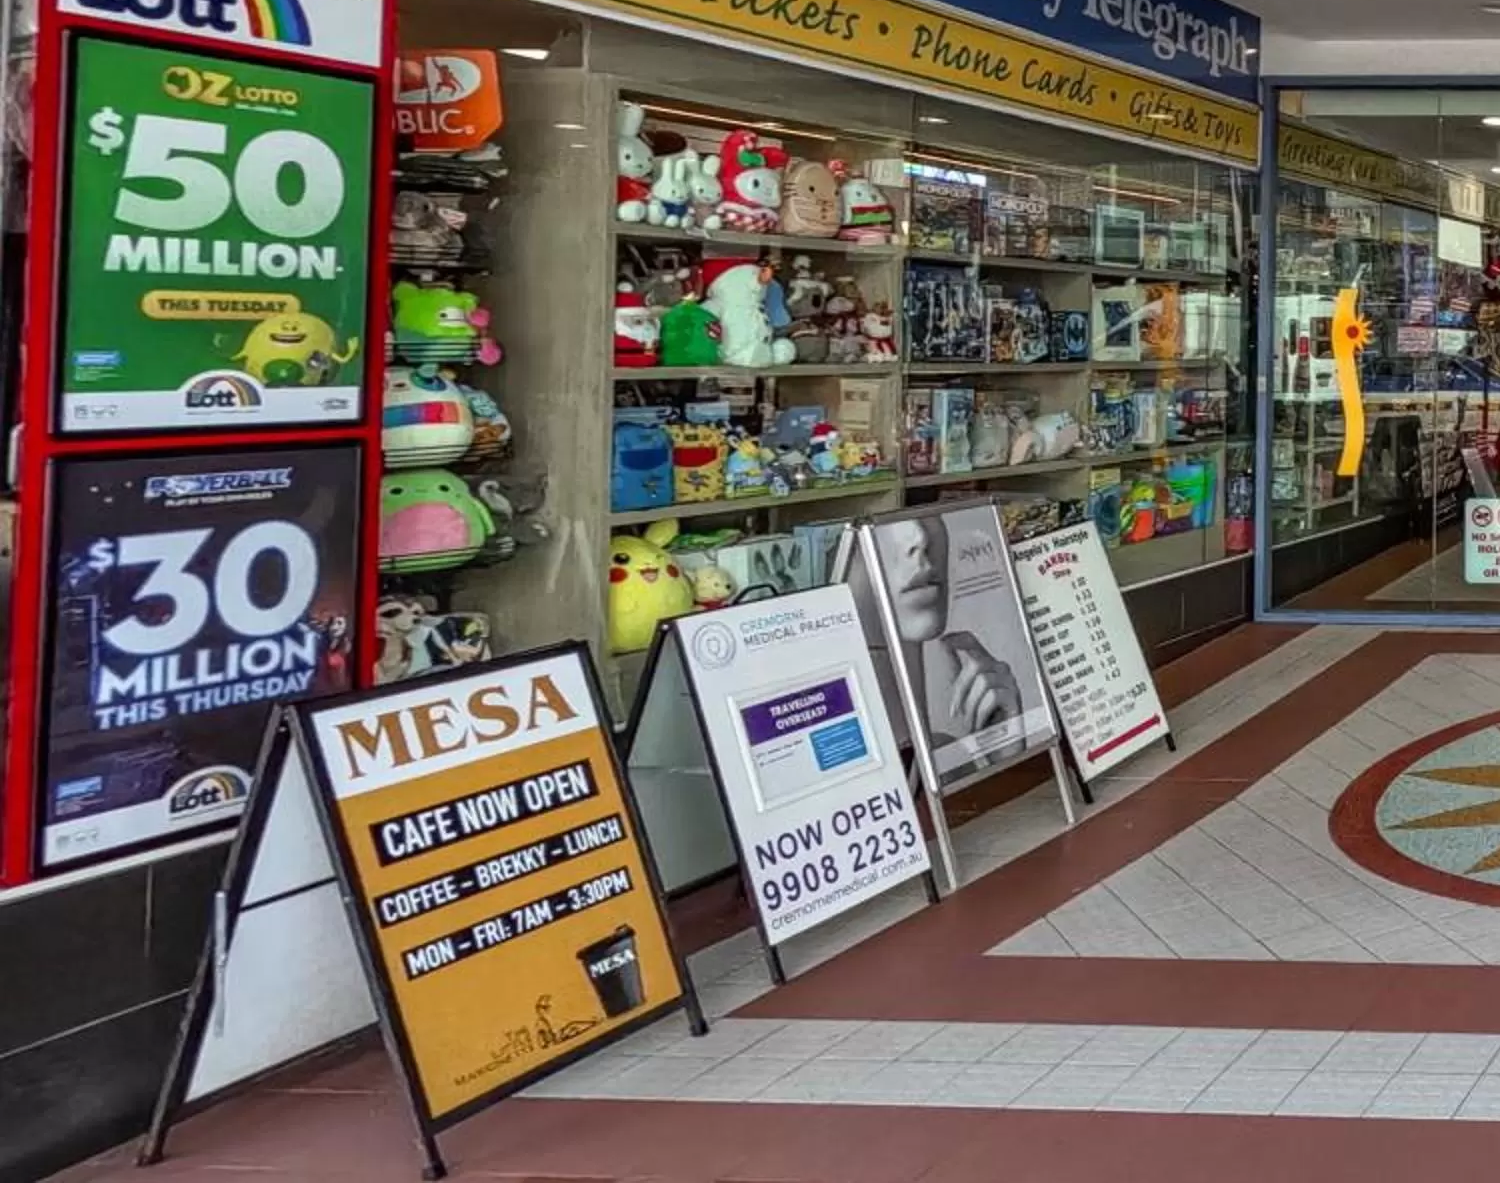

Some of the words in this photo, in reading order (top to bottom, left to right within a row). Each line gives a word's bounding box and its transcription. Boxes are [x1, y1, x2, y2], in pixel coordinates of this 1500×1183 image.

[162, 66, 234, 106] OZ
[235, 85, 298, 105] LOTTO
[392, 109, 464, 135] BLIC
[911, 22, 1012, 81] Phone
[1021, 59, 1099, 106] Cards
[1204, 111, 1243, 149] Toys
[158, 298, 200, 311] THIS
[207, 298, 288, 313] TUESDAY
[98, 630, 318, 705] MILLION
[743, 626, 798, 648] MEDICAL
[94, 698, 167, 731] THIS
[177, 669, 315, 716] THURSDAY
[334, 674, 580, 781] MESA
[381, 807, 457, 859] CAFE
[456, 786, 519, 834] NOW
[522, 764, 590, 811] OPEN
[755, 820, 823, 870] NOW
[832, 789, 903, 836] OPEN
[380, 876, 460, 923] COFFEE
[474, 843, 549, 888] BREKKY
[563, 817, 623, 856] LUNCH
[763, 854, 840, 911] 9908
[848, 820, 917, 873] 2233
[406, 938, 456, 977] MON
[472, 919, 512, 950] FRI:
[511, 900, 554, 933] 7AM
[567, 869, 630, 911] 3:30PM
[590, 948, 636, 978] MESA
